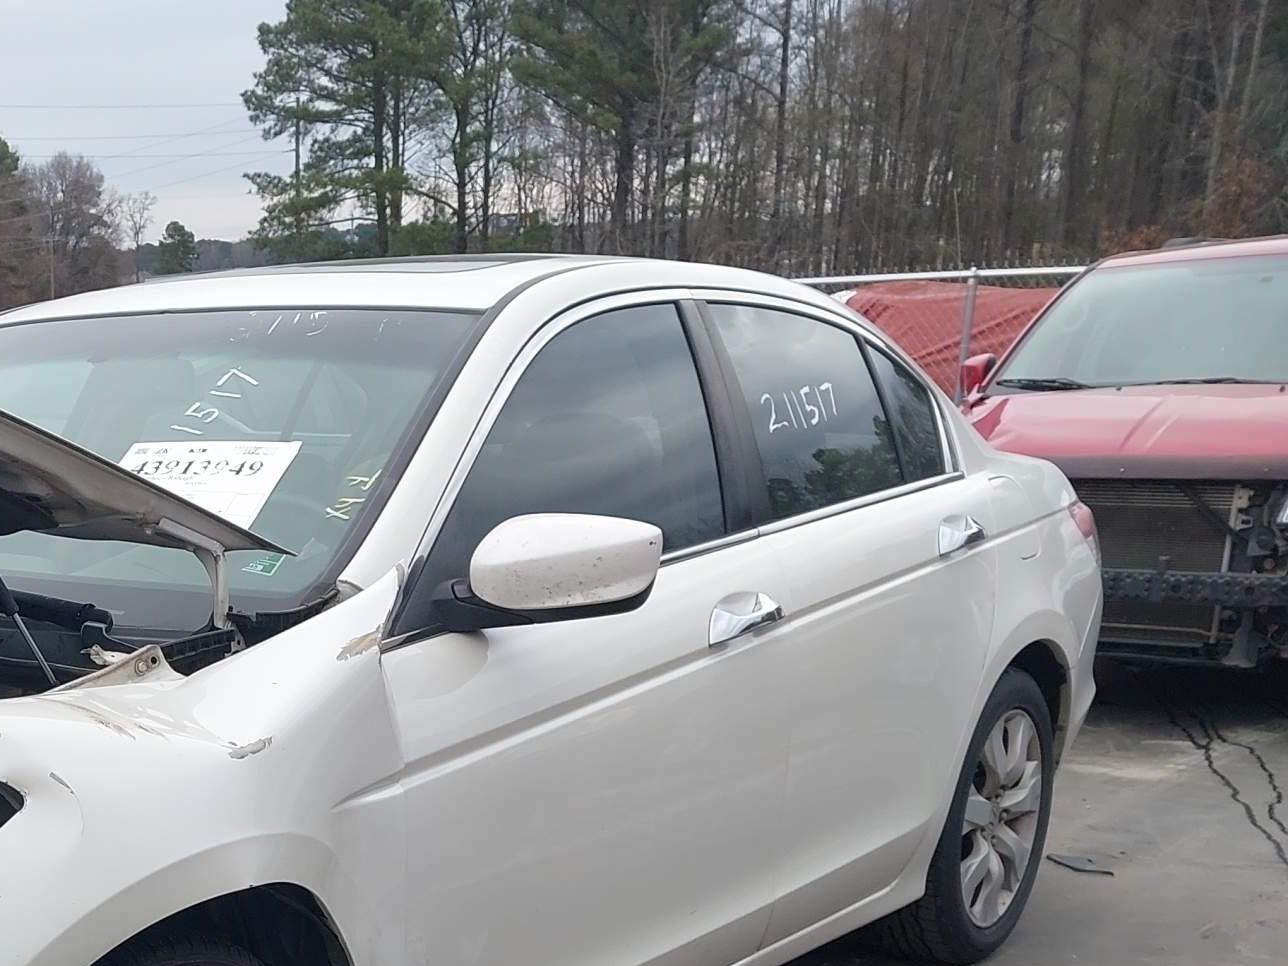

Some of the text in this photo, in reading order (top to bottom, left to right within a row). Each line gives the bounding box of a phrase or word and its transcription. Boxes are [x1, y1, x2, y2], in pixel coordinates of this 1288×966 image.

[169, 366, 260, 435] 1517
[760, 381, 838, 433] 211517
[130, 459, 264, 477] 43913949
